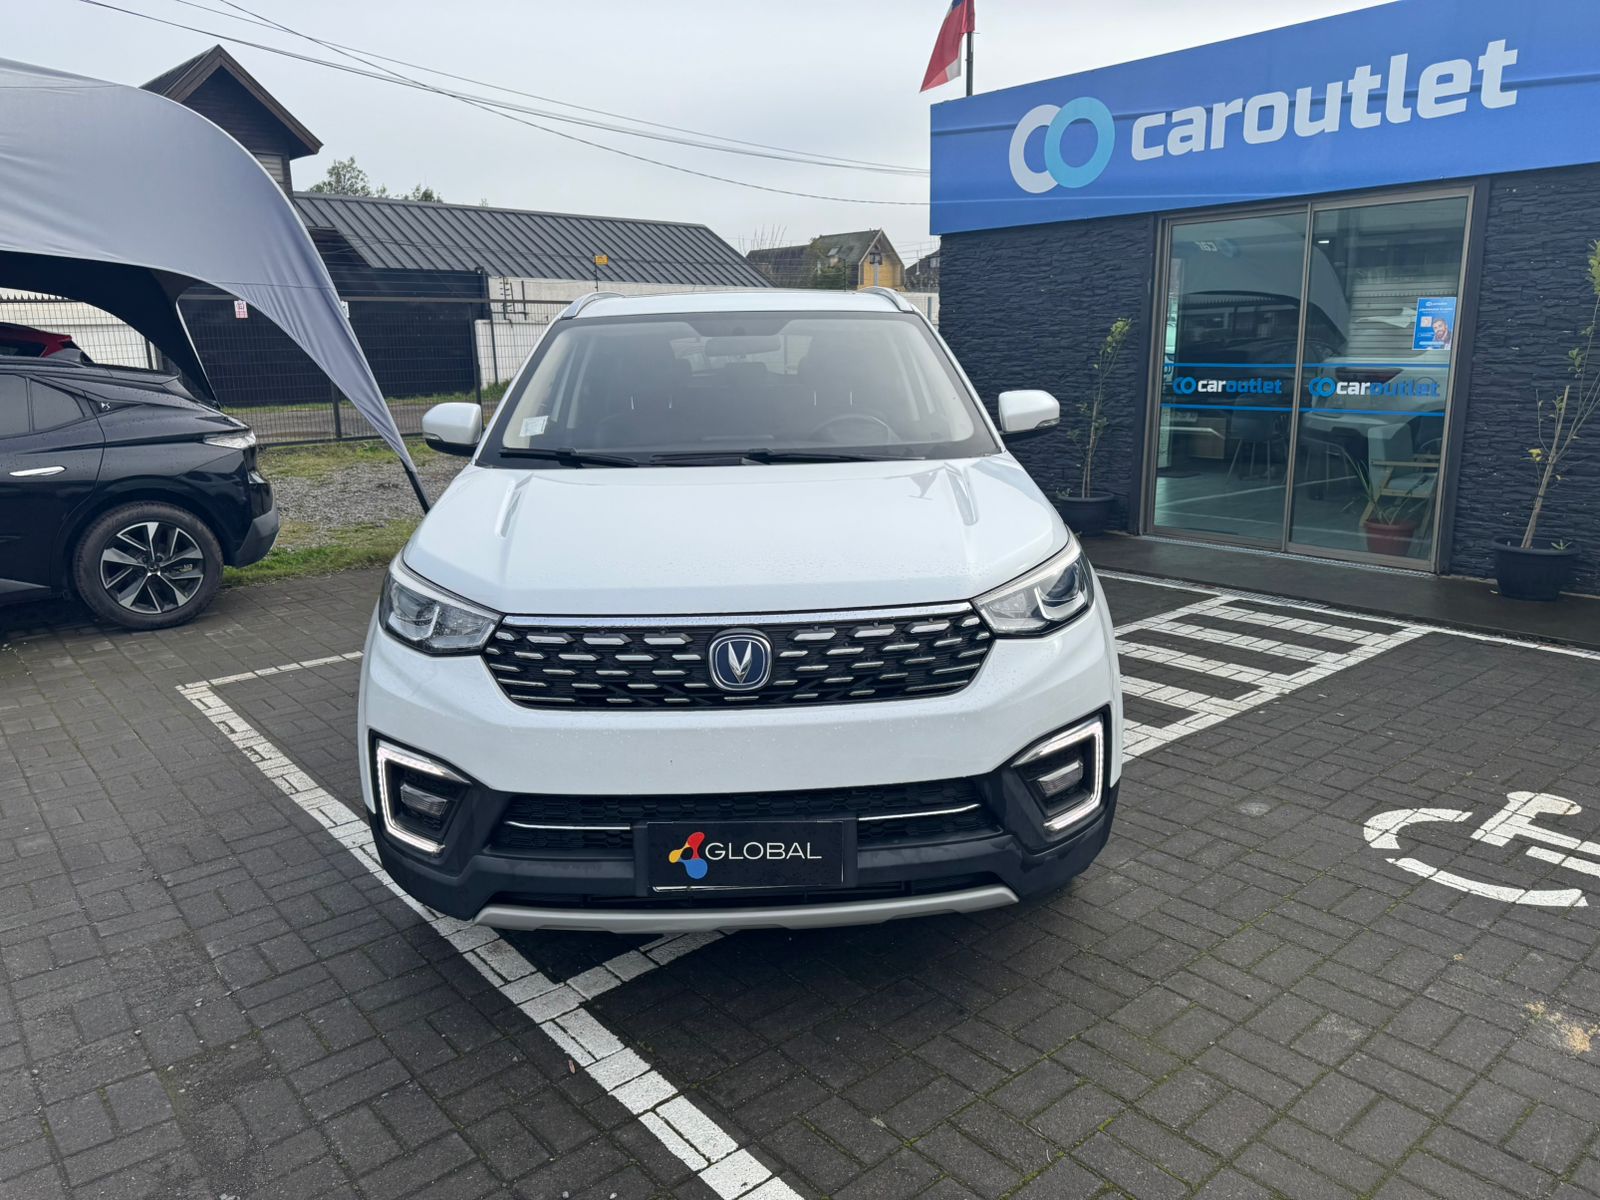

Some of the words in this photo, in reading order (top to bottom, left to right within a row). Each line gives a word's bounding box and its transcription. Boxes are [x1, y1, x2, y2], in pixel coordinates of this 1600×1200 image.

[1131, 39, 1518, 161] caroutlet
[1197, 377, 1282, 394] caroutlet
[1336, 378, 1440, 398] caroutlet
[705, 841, 822, 861] GLOBAL
